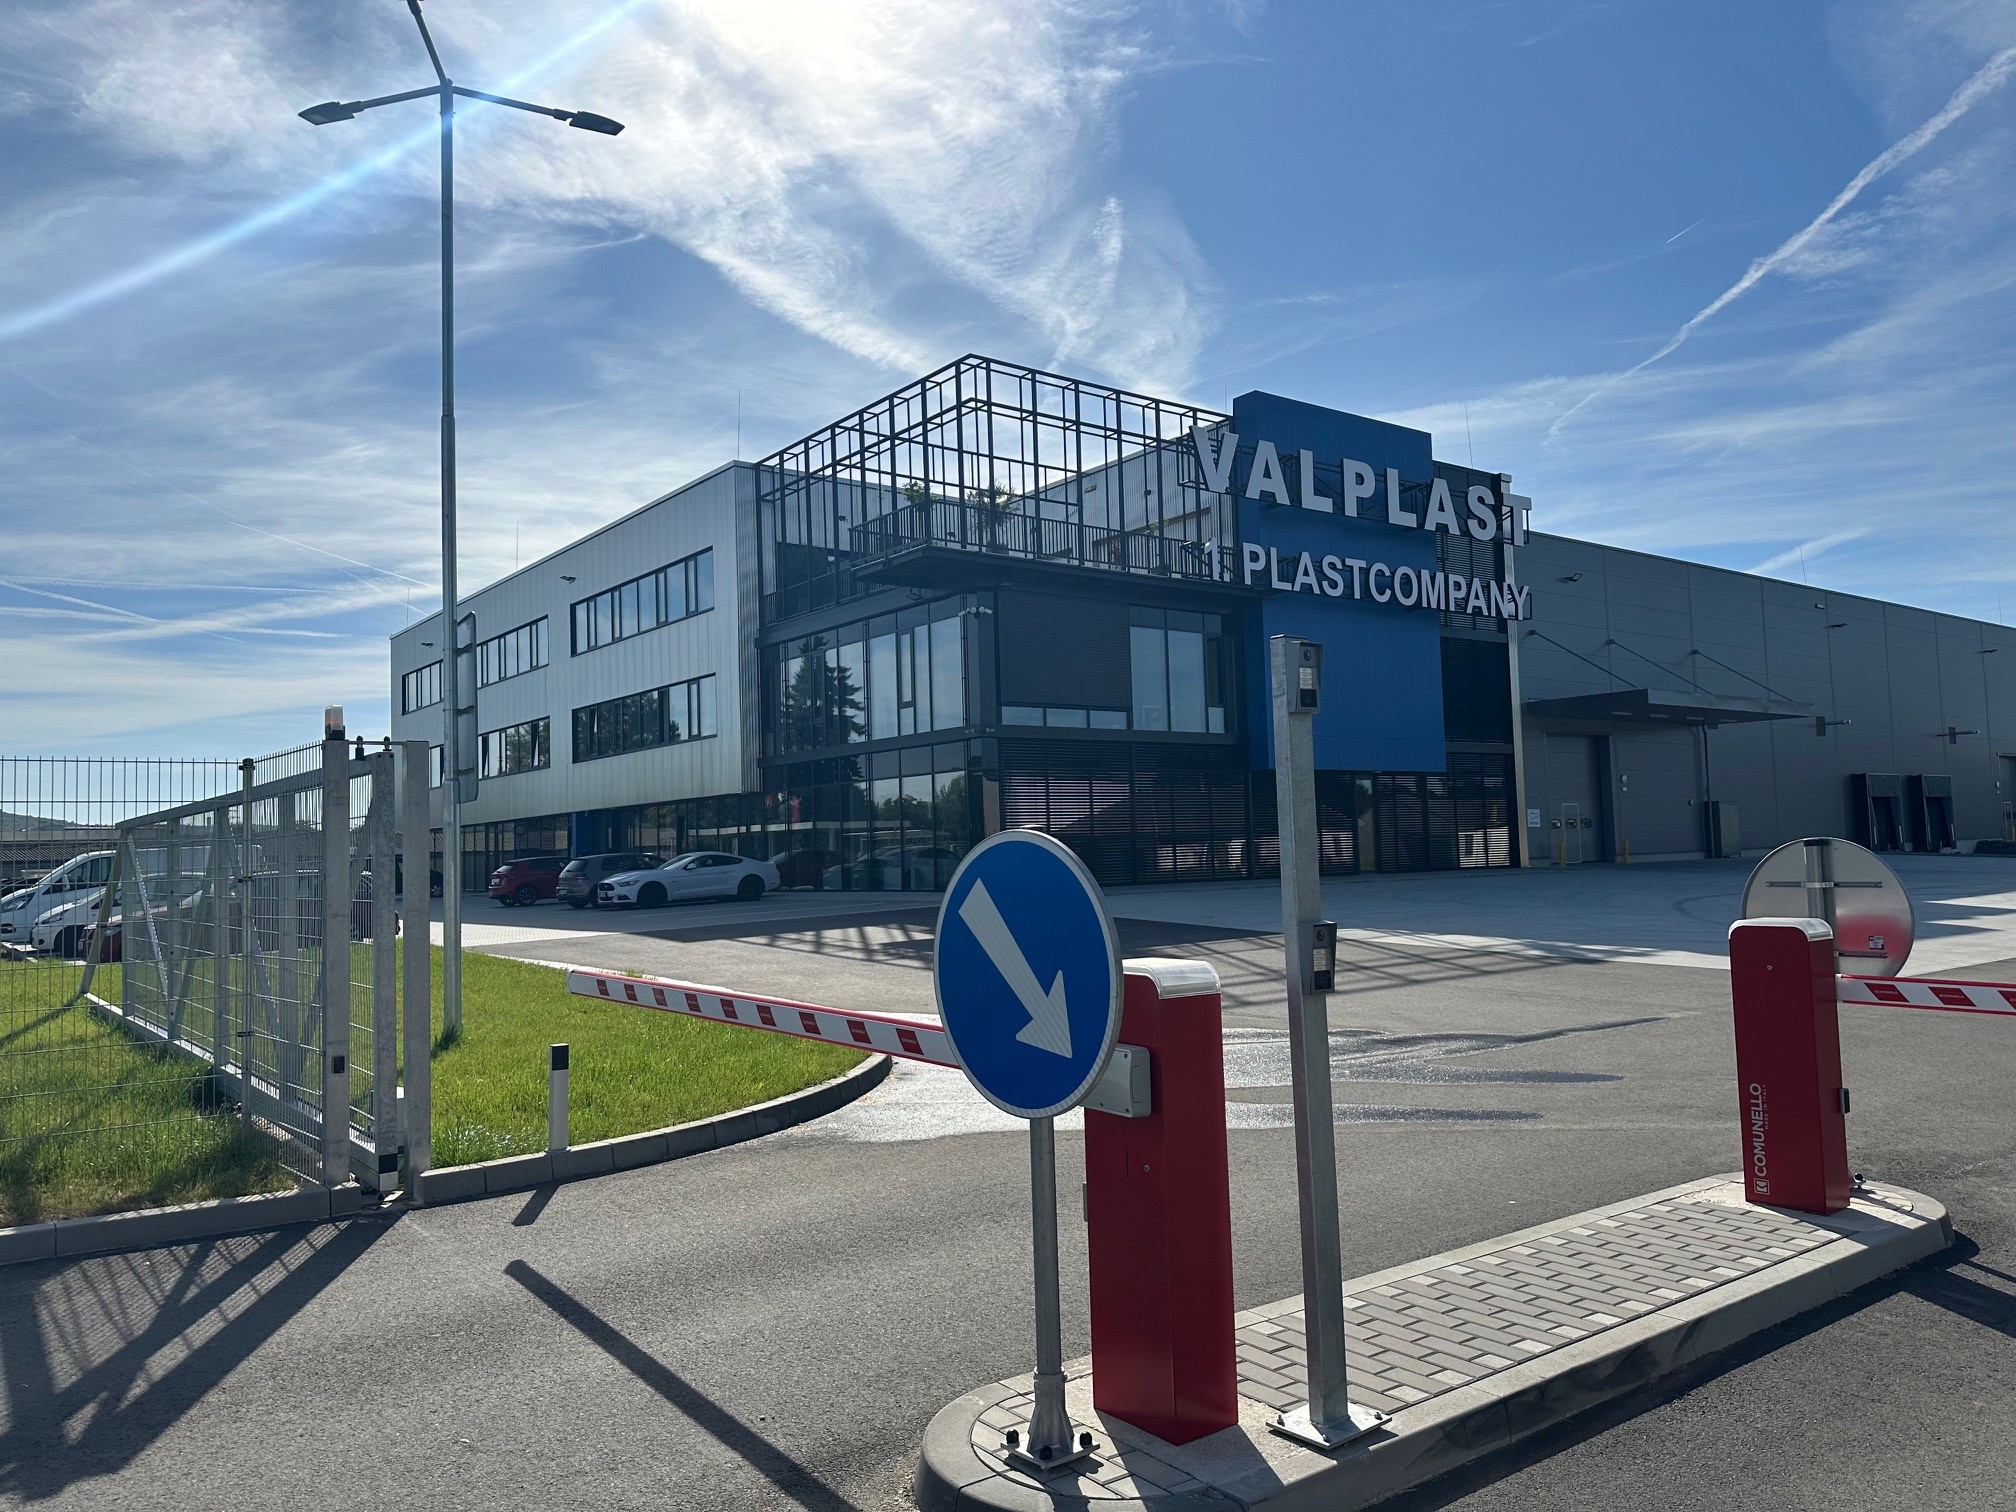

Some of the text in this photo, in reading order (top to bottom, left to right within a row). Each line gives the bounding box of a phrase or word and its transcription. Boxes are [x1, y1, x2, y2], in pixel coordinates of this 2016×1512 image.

[1189, 426, 1532, 546] VALPLAST
[1243, 541, 1530, 621] PLASTCOMPANY
[1749, 1083, 1767, 1177] COMUNELLO
